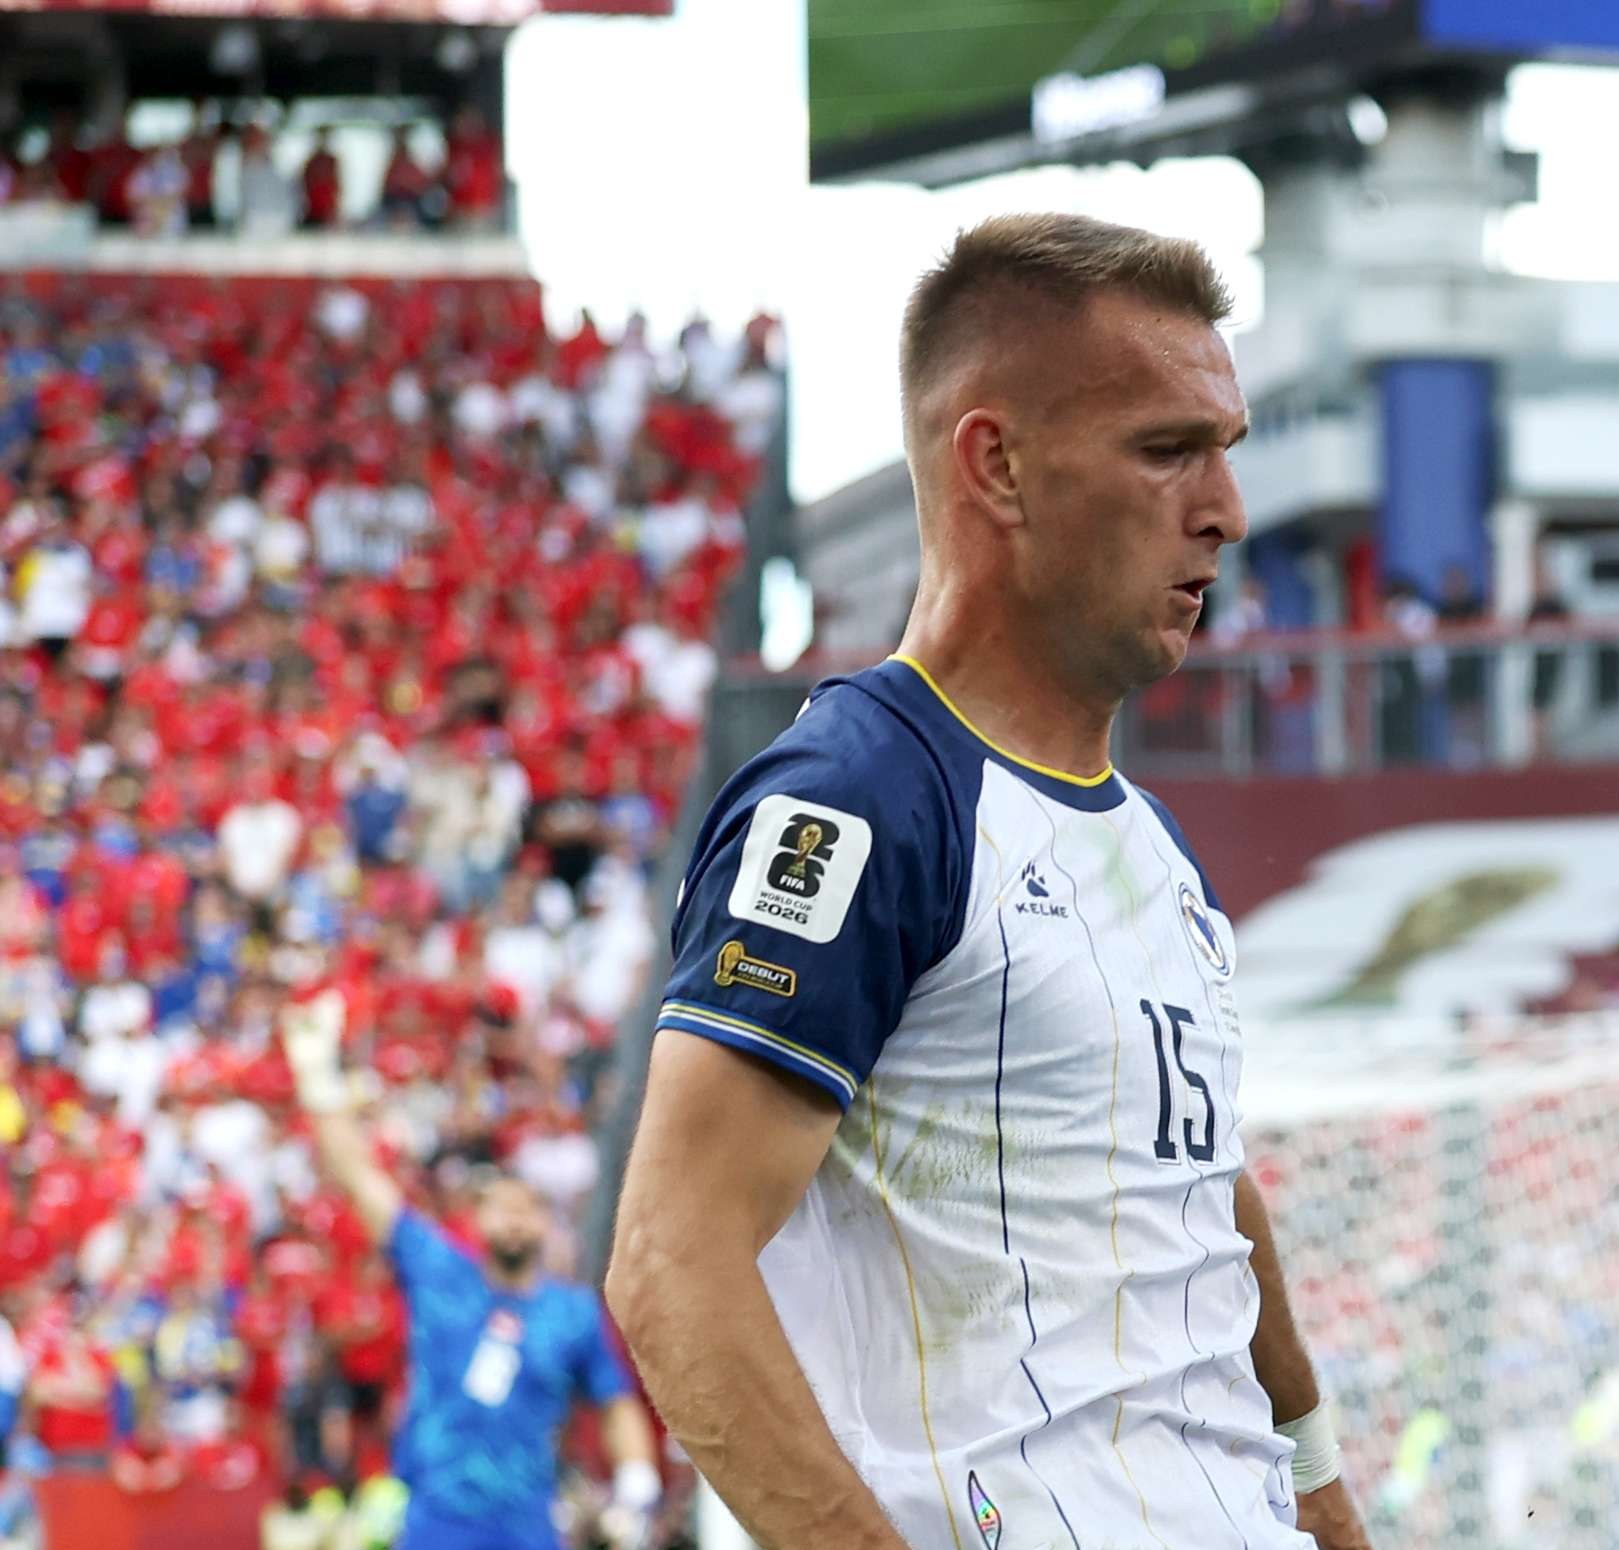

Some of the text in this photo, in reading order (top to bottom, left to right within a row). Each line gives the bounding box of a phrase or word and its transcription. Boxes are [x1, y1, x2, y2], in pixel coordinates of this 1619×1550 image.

[779, 875, 806, 891] FIFA
[760, 891, 814, 912] WORLD CUP
[1015, 902, 1069, 919] KELME
[754, 900, 809, 926] 2026
[737, 962, 790, 984] DEBUT
[1140, 998, 1217, 1165] 15
